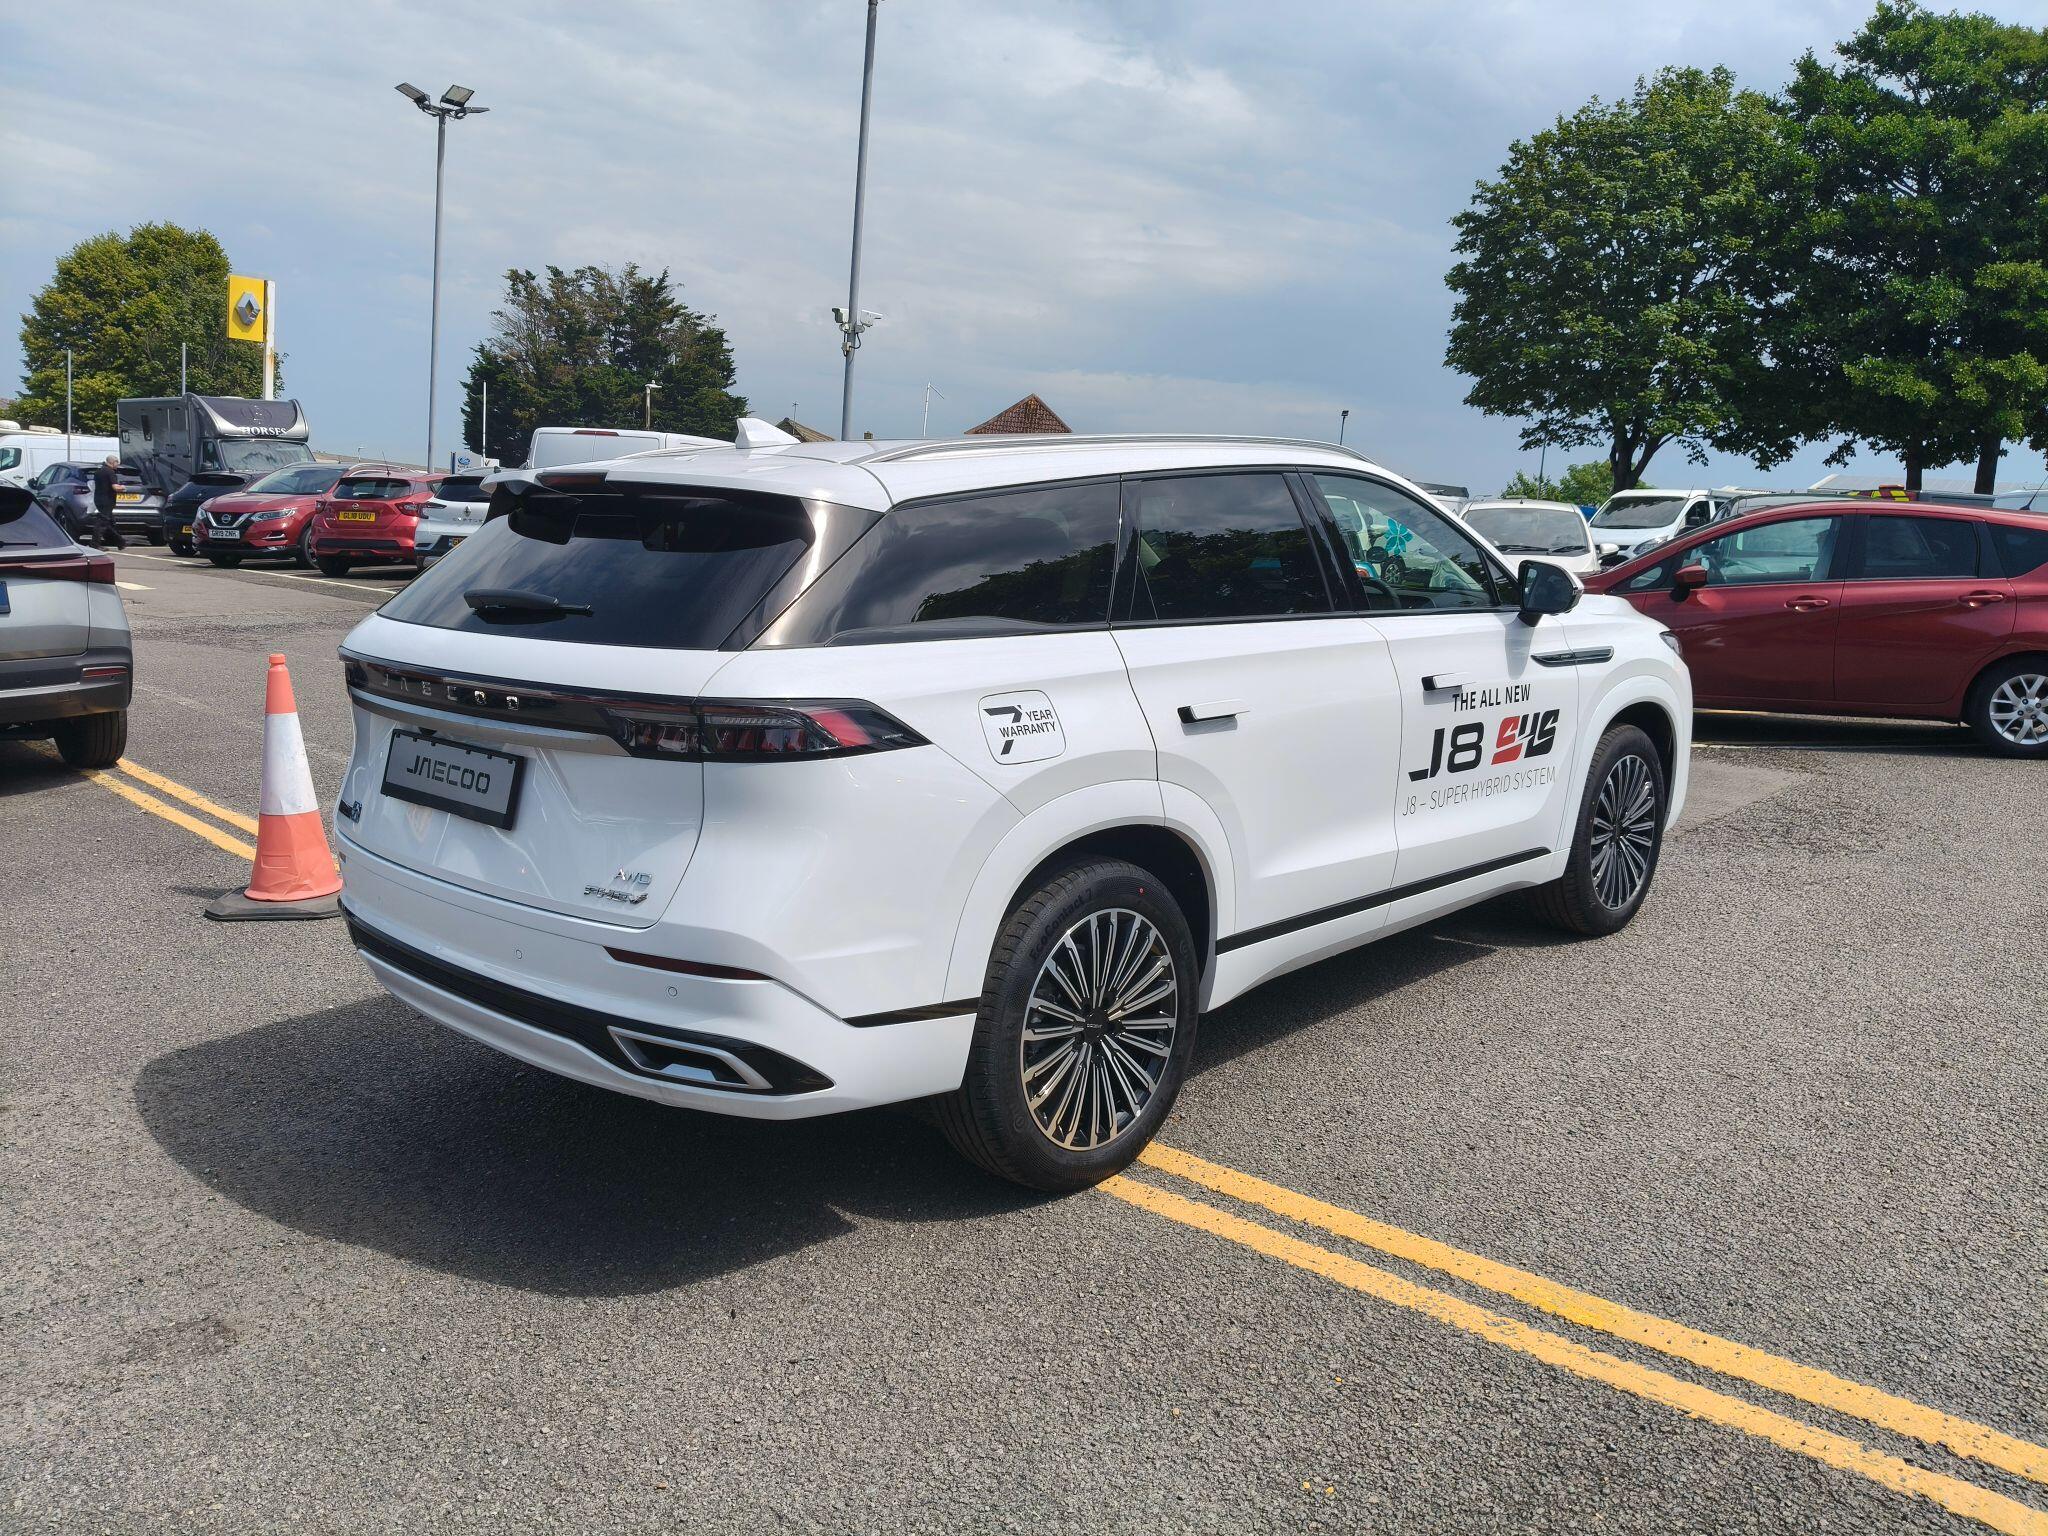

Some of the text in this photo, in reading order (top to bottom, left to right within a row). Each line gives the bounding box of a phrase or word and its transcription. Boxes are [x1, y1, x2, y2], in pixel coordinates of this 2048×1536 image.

[241, 426, 287, 436] HORSES
[1452, 683, 1531, 712] THE ALL NEW
[1025, 709, 1054, 722] YEAR
[998, 721, 1056, 738] WARRANTY
[1408, 722, 1484, 782] J8
[406, 755, 490, 794] JAECOO
[1402, 795, 1417, 816] J8
[1429, 783, 1469, 811] SUPER
[1471, 774, 1510, 800] HYBRID
[1512, 766, 1556, 791] SYSTEM
[613, 868, 652, 885] AWD
